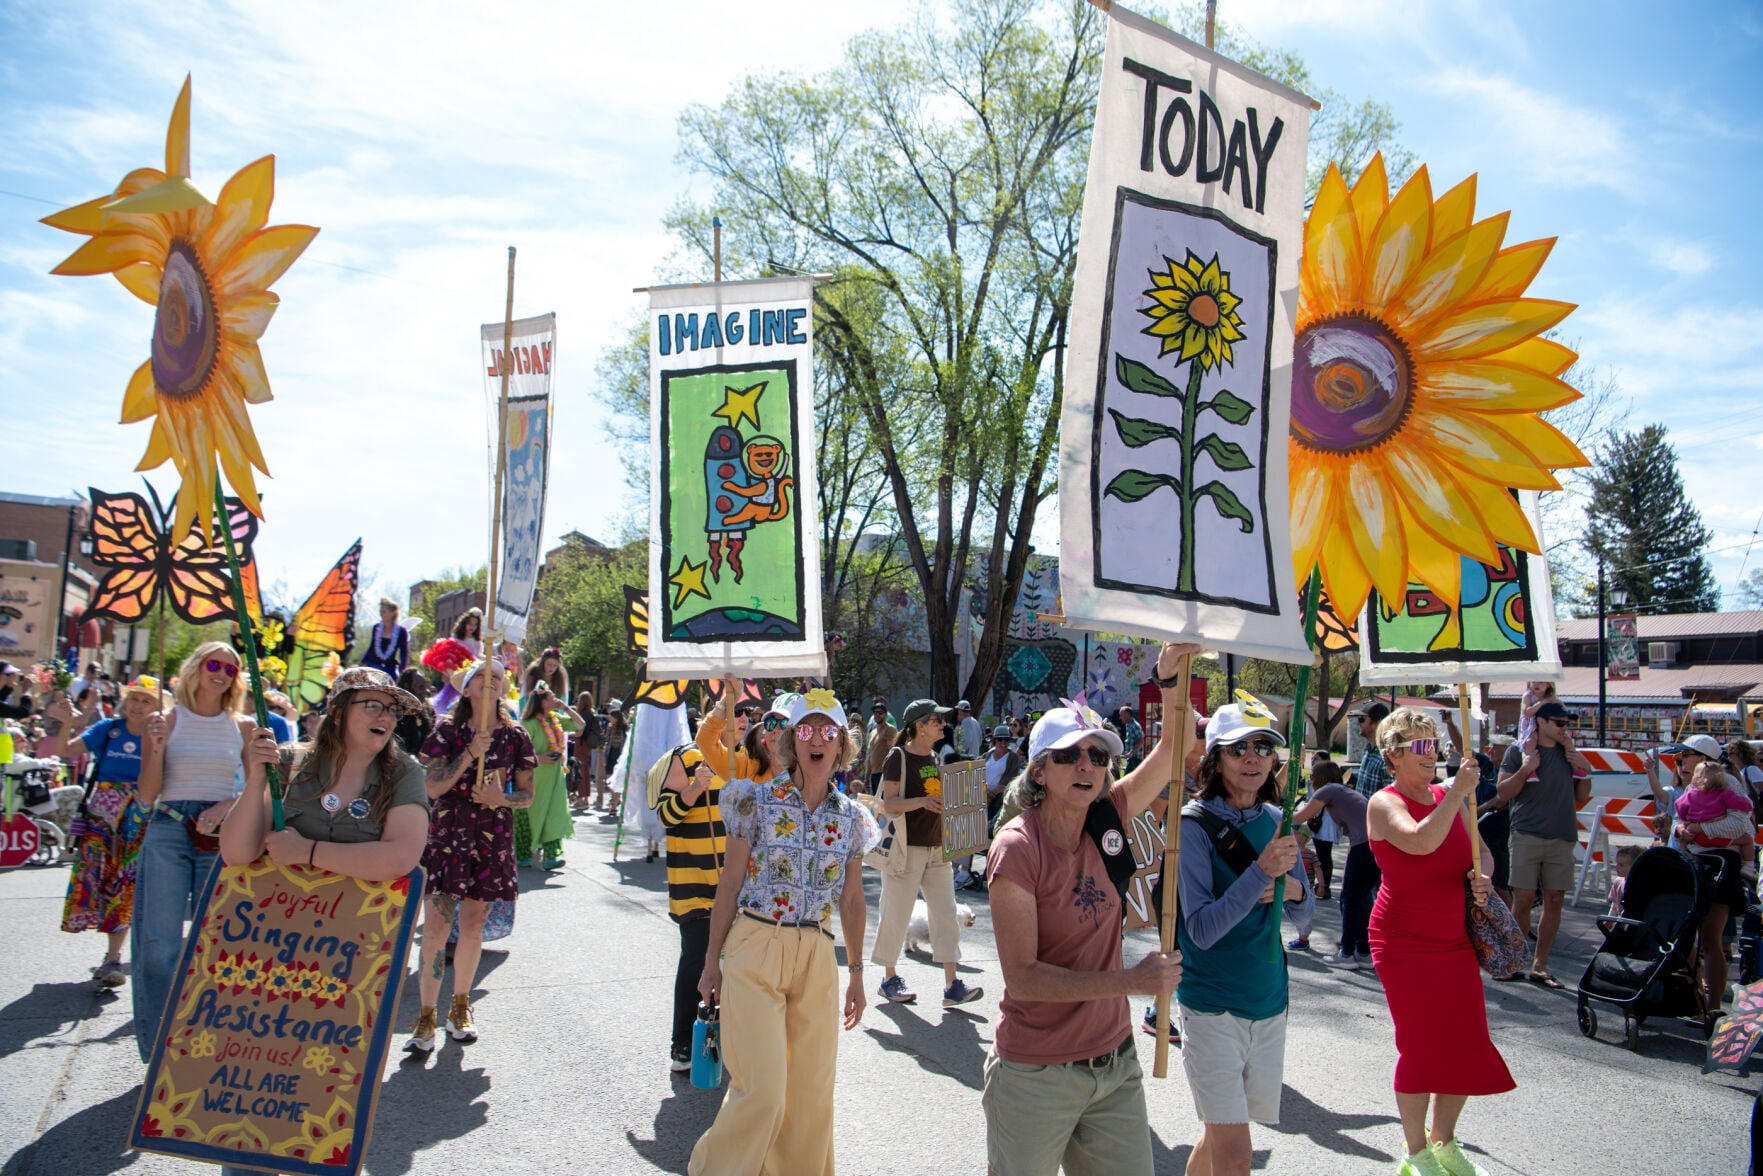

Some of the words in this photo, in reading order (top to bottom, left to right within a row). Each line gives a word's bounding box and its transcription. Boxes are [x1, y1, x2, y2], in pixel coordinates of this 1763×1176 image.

[1122, 56, 1285, 216] TODAY
[658, 308, 808, 356] IMAGINE
[1107, 837, 1120, 848] ICE
[259, 883, 344, 919] joyful
[222, 901, 359, 979] Singing
[187, 989, 364, 1048] Resistance
[215, 1036, 269, 1063] join
[270, 1045, 302, 1067] us!
[209, 1065, 253, 1091] ALL
[257, 1072, 302, 1096] ARE
[203, 1088, 311, 1123] WELCOME
